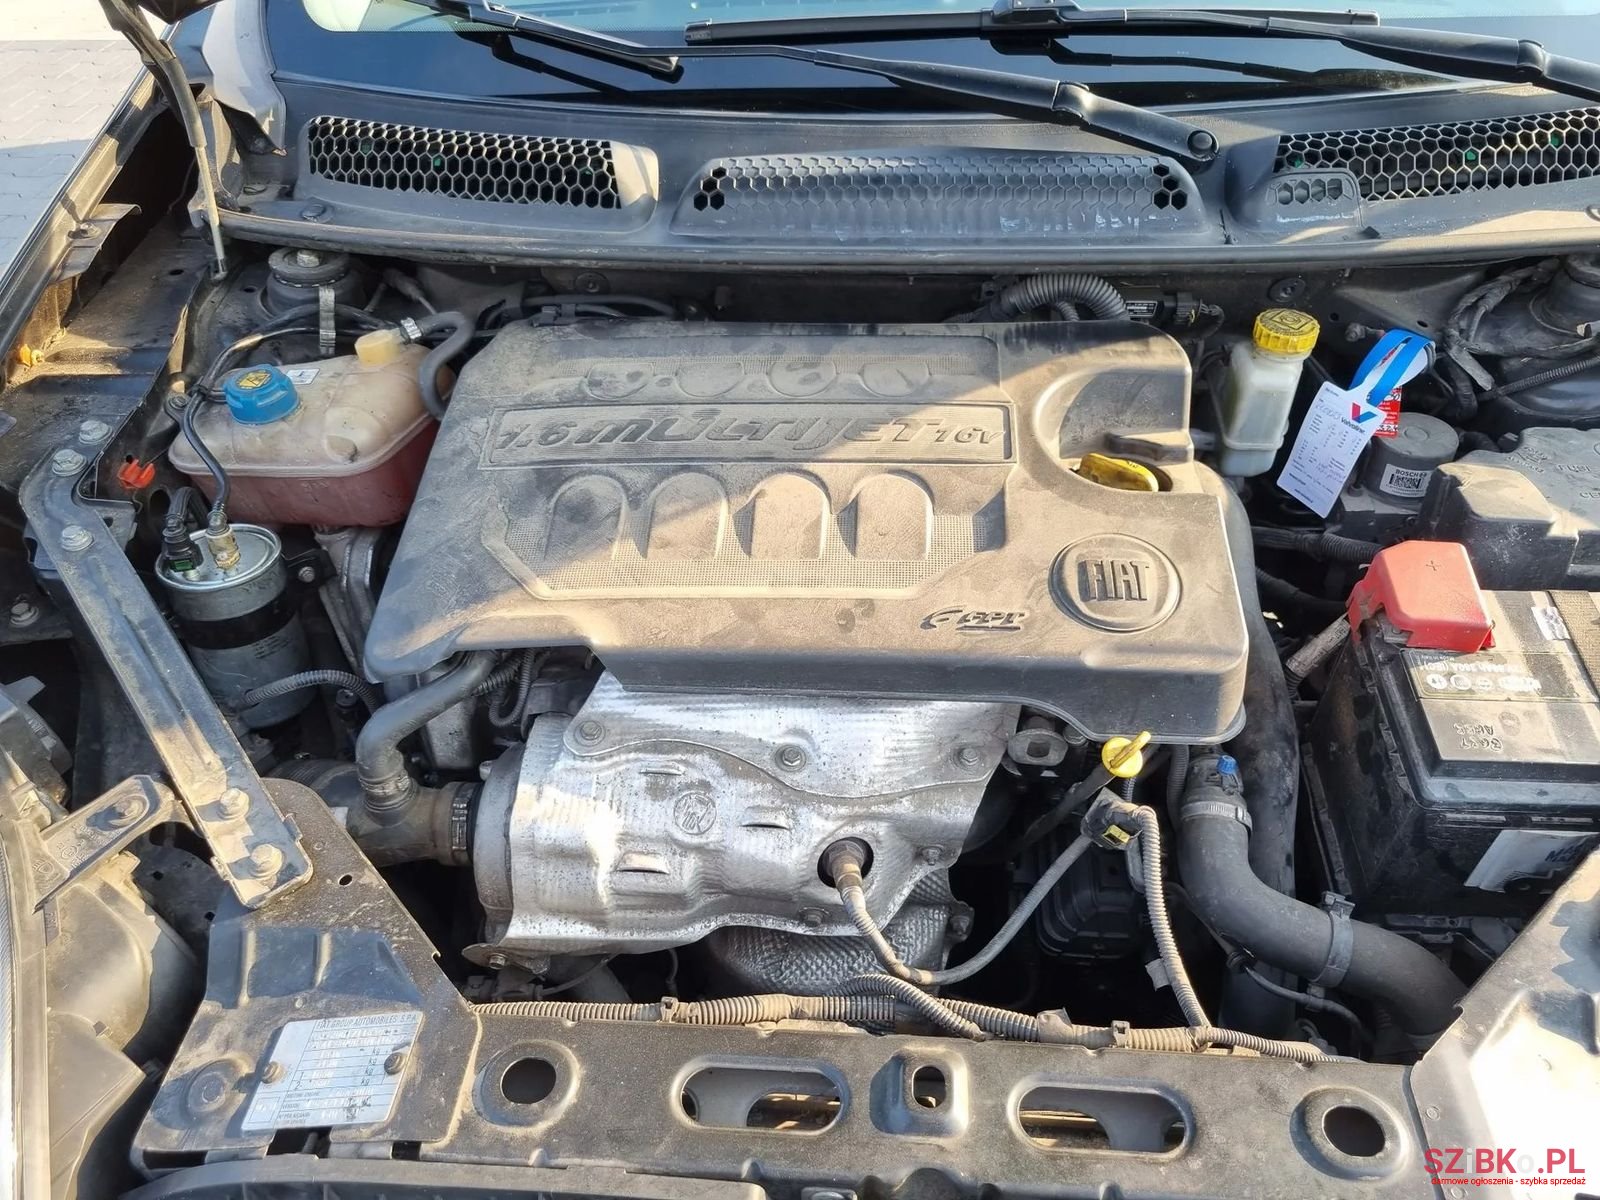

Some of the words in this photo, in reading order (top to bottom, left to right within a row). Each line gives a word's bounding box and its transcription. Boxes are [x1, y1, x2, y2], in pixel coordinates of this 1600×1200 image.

[497, 421, 557, 449] 1.6
[1396, 468, 1419, 477] BOSCH
[1077, 559, 1150, 601] FIAT
[330, 1019, 354, 1028] GROUP
[353, 1015, 397, 1026] AUTOMOBILES
